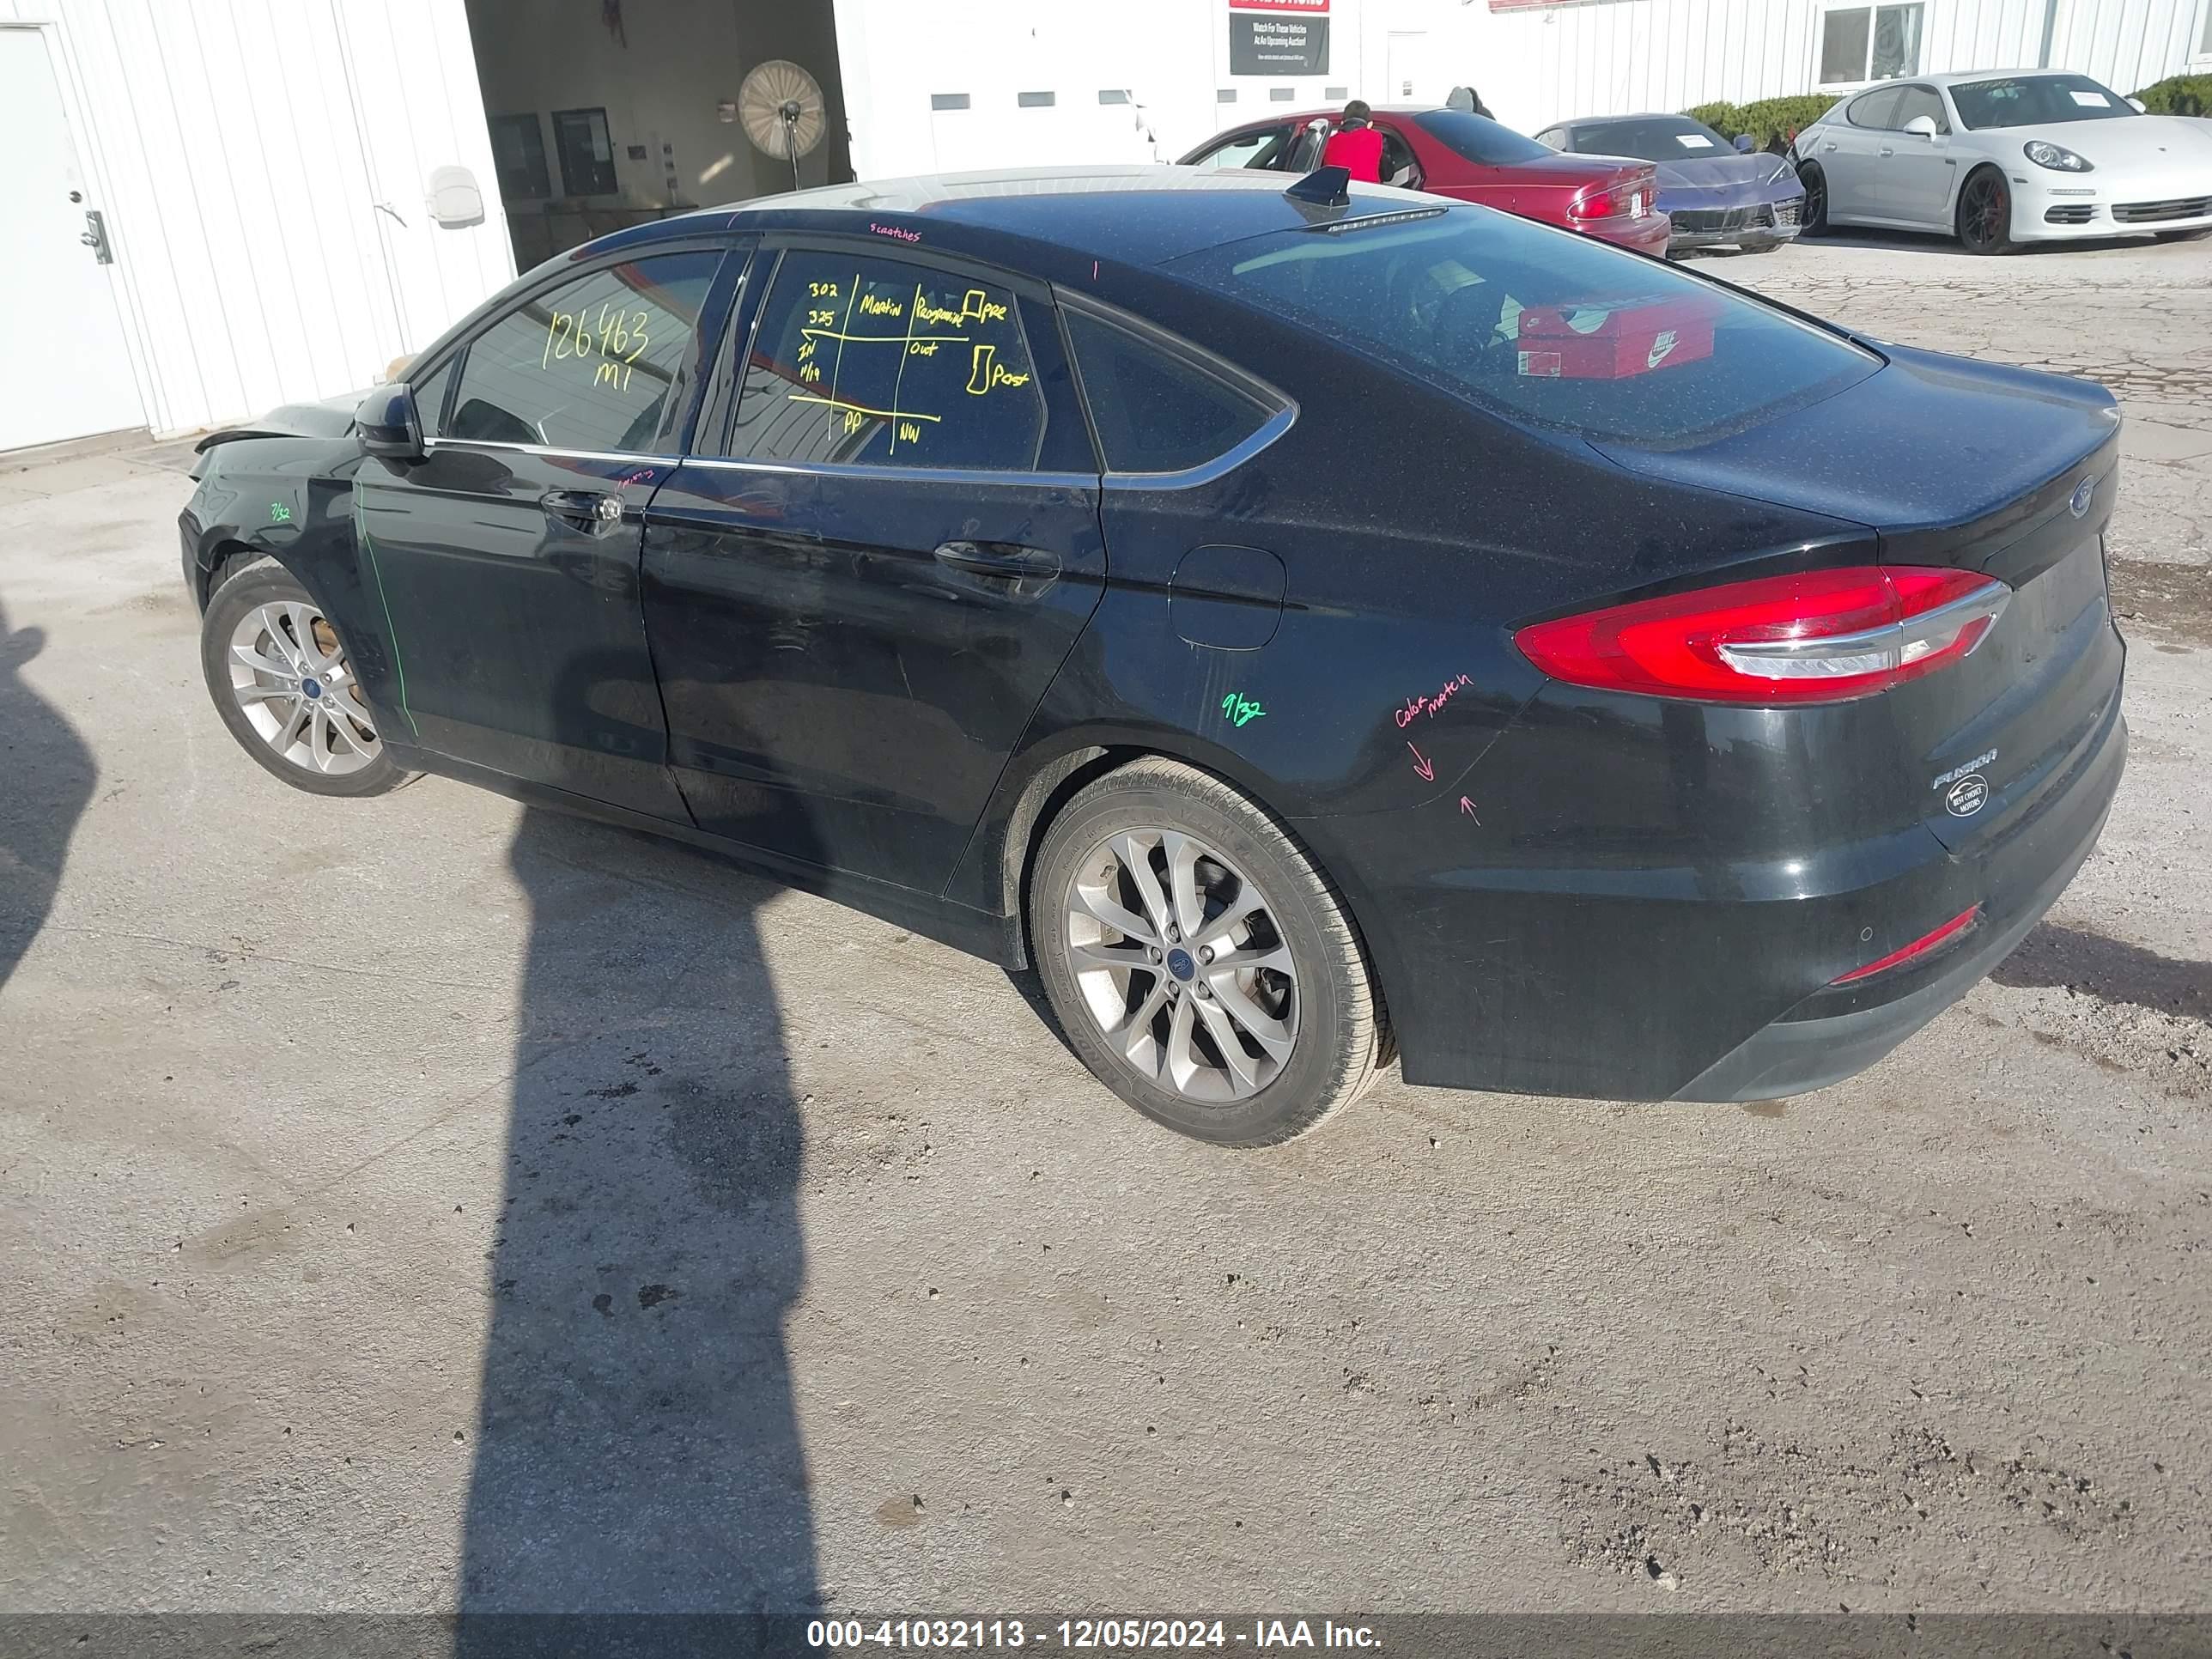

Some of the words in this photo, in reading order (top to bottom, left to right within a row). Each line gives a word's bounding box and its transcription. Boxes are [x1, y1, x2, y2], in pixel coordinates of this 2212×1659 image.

[809, 283, 838, 297] 302
[809, 310, 835, 326] 325
[543, 302, 649, 370] 126463
[1221, 692, 1267, 728] 9/32
[1953, 794, 1965, 807] BEST
[1964, 786, 1984, 801] CHOICE
[1960, 797, 1981, 813] MOTORS
